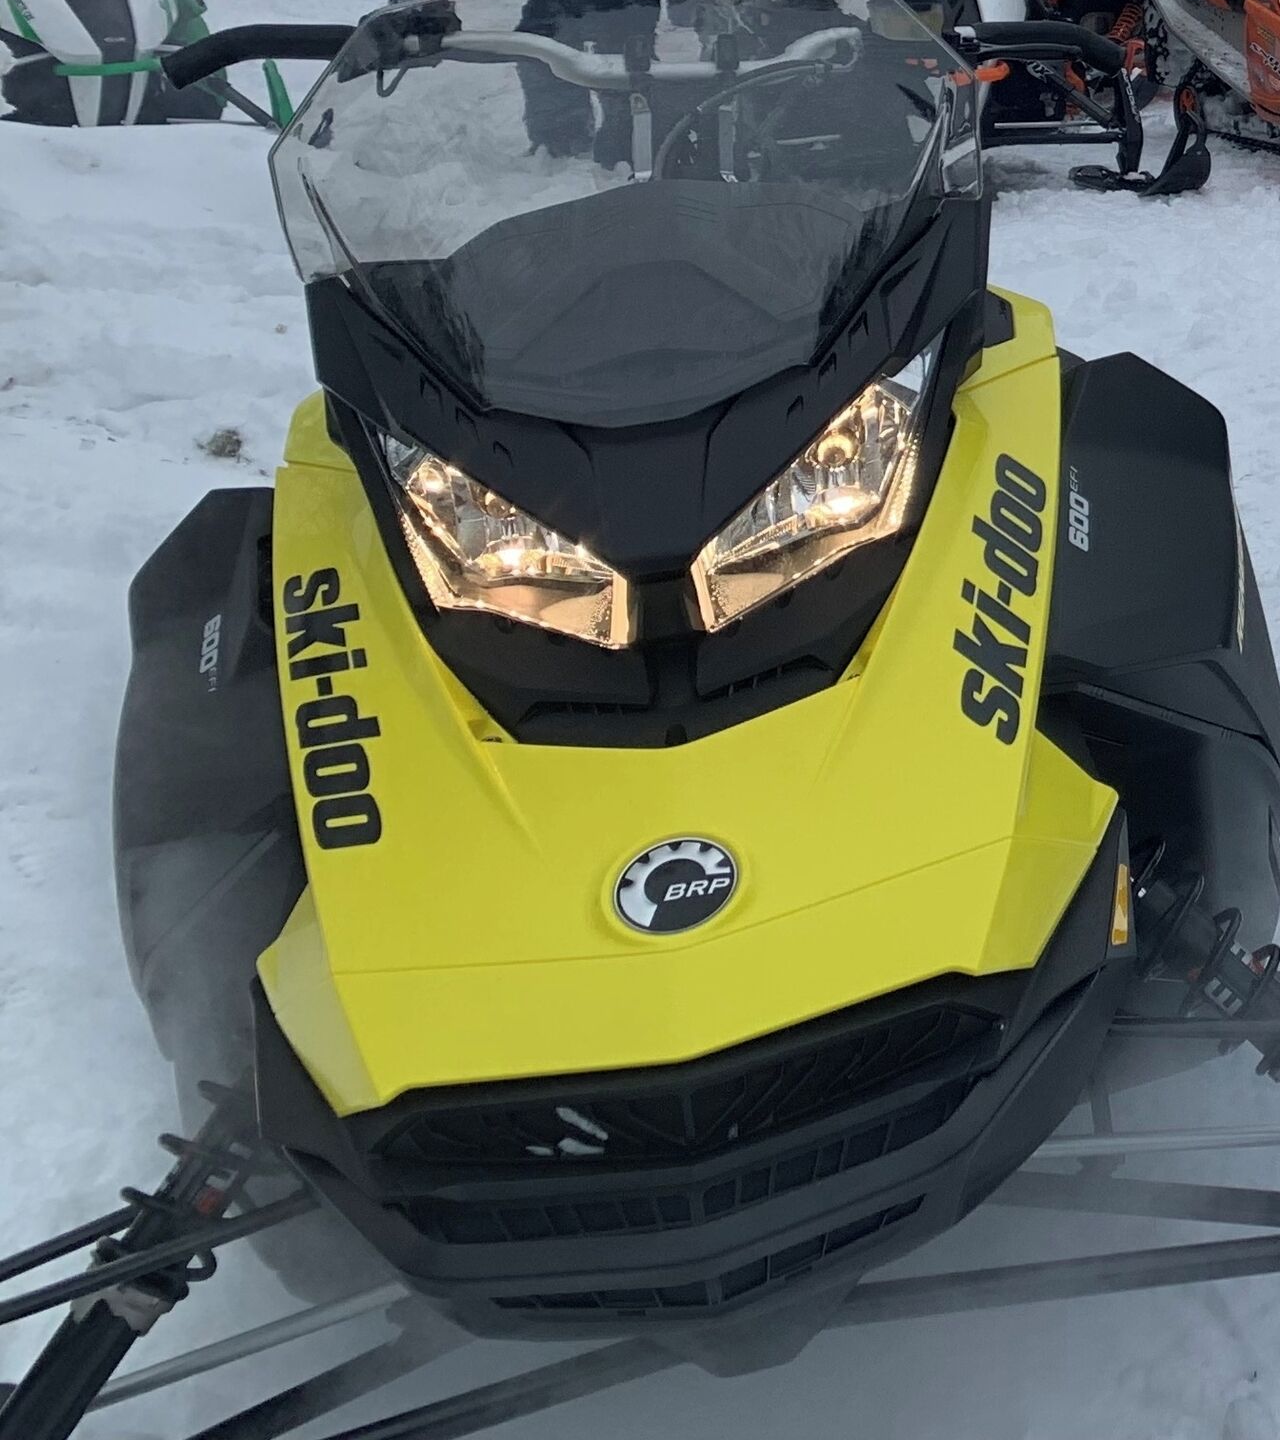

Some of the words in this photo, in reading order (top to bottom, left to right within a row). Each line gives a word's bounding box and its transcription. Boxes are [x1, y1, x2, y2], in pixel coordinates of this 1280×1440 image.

[1068, 491, 1090, 552] 600
[953, 452, 1047, 746] ski-doo
[199, 613, 221, 674] 600
[283, 567, 382, 850] ski-doo
[663, 877, 730, 902] BRP
